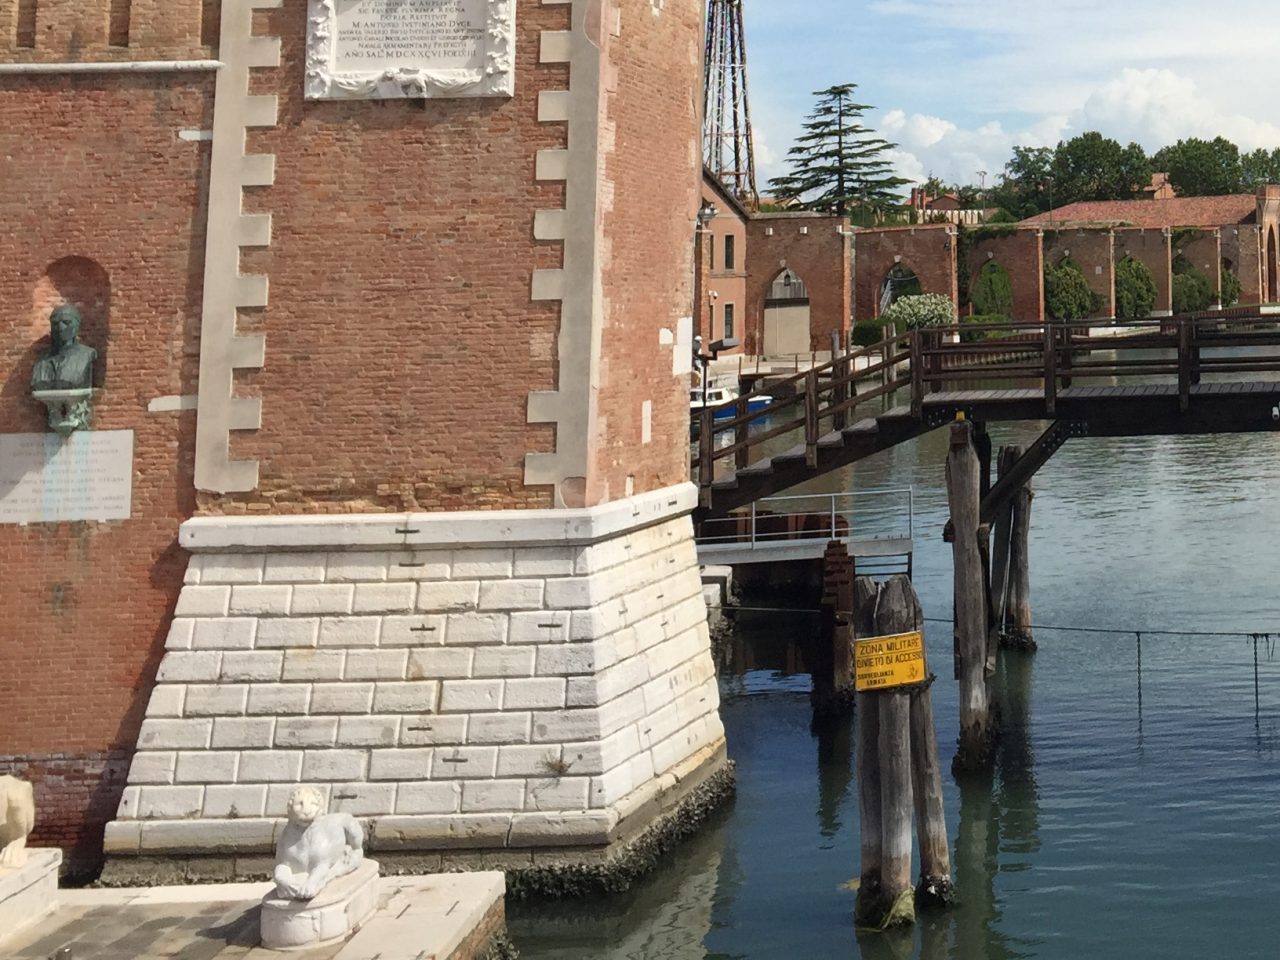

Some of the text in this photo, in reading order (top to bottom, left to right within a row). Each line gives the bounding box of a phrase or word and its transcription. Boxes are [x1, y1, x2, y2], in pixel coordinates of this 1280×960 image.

[859, 637, 919, 656] ZONA MILITARE
[856, 650, 924, 669] DIVIETO DI ACCESSO
